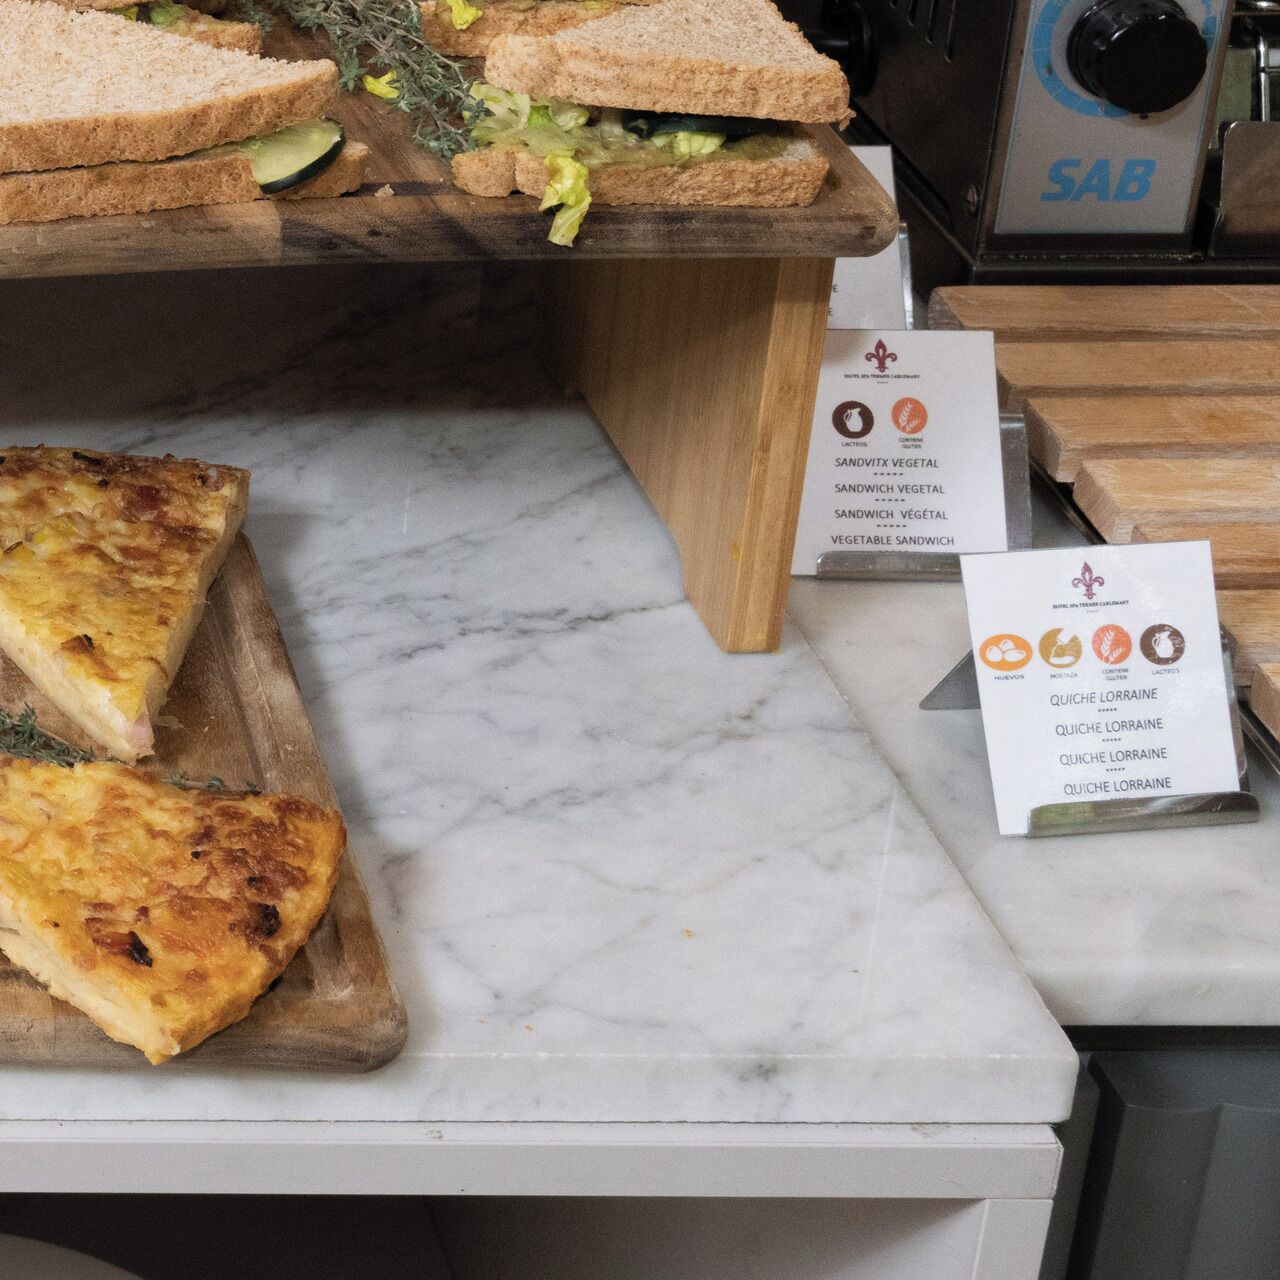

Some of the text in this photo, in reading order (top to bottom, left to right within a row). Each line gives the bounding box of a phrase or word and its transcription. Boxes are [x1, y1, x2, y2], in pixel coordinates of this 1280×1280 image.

[1040, 159, 1157, 202] SAB
[835, 457, 939, 469] SANDVITX VEGETAL
[834, 483, 945, 495] SANDWICH VEGETAL
[834, 507, 948, 520] SANDWICH VÉGÉTAL
[831, 535, 954, 546] VEGETABLE SANDWICH
[1050, 687, 1159, 707] QUICHE LORRAINE
[1055, 718, 1164, 737] QUICHE LORRAINE
[1059, 747, 1168, 767] QUICHE LORRAINE
[1064, 776, 1172, 796] QUICHE LORRAINE
